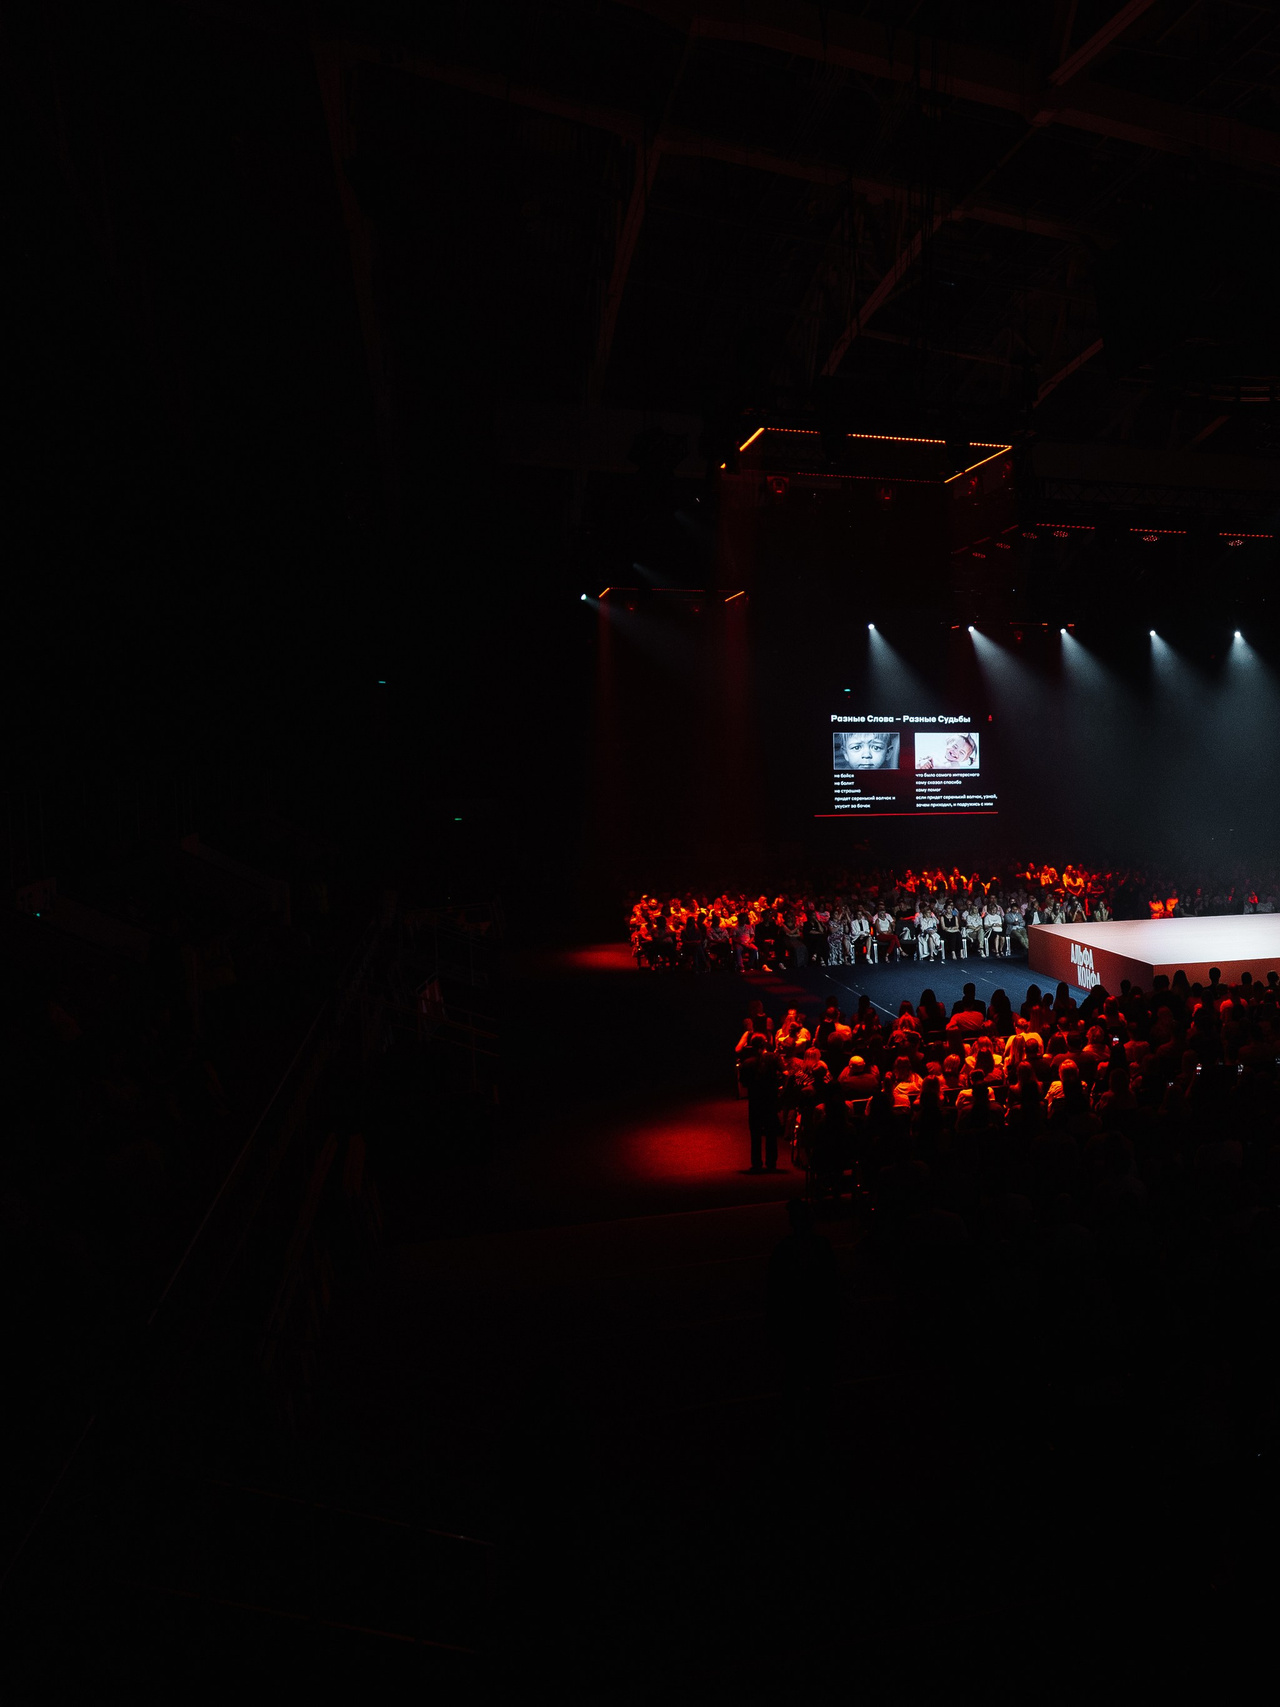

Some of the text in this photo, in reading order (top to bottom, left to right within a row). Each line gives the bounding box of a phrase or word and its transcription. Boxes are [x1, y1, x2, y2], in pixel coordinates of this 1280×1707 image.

[831, 714, 866, 723] Разные
[867, 715, 894, 723] Слова
[903, 715, 936, 723] Разные
[938, 715, 971, 724] Судьбы
[1070, 942, 1094, 970] АЛЬФА
[1077, 965, 1101, 990] КОНФА
